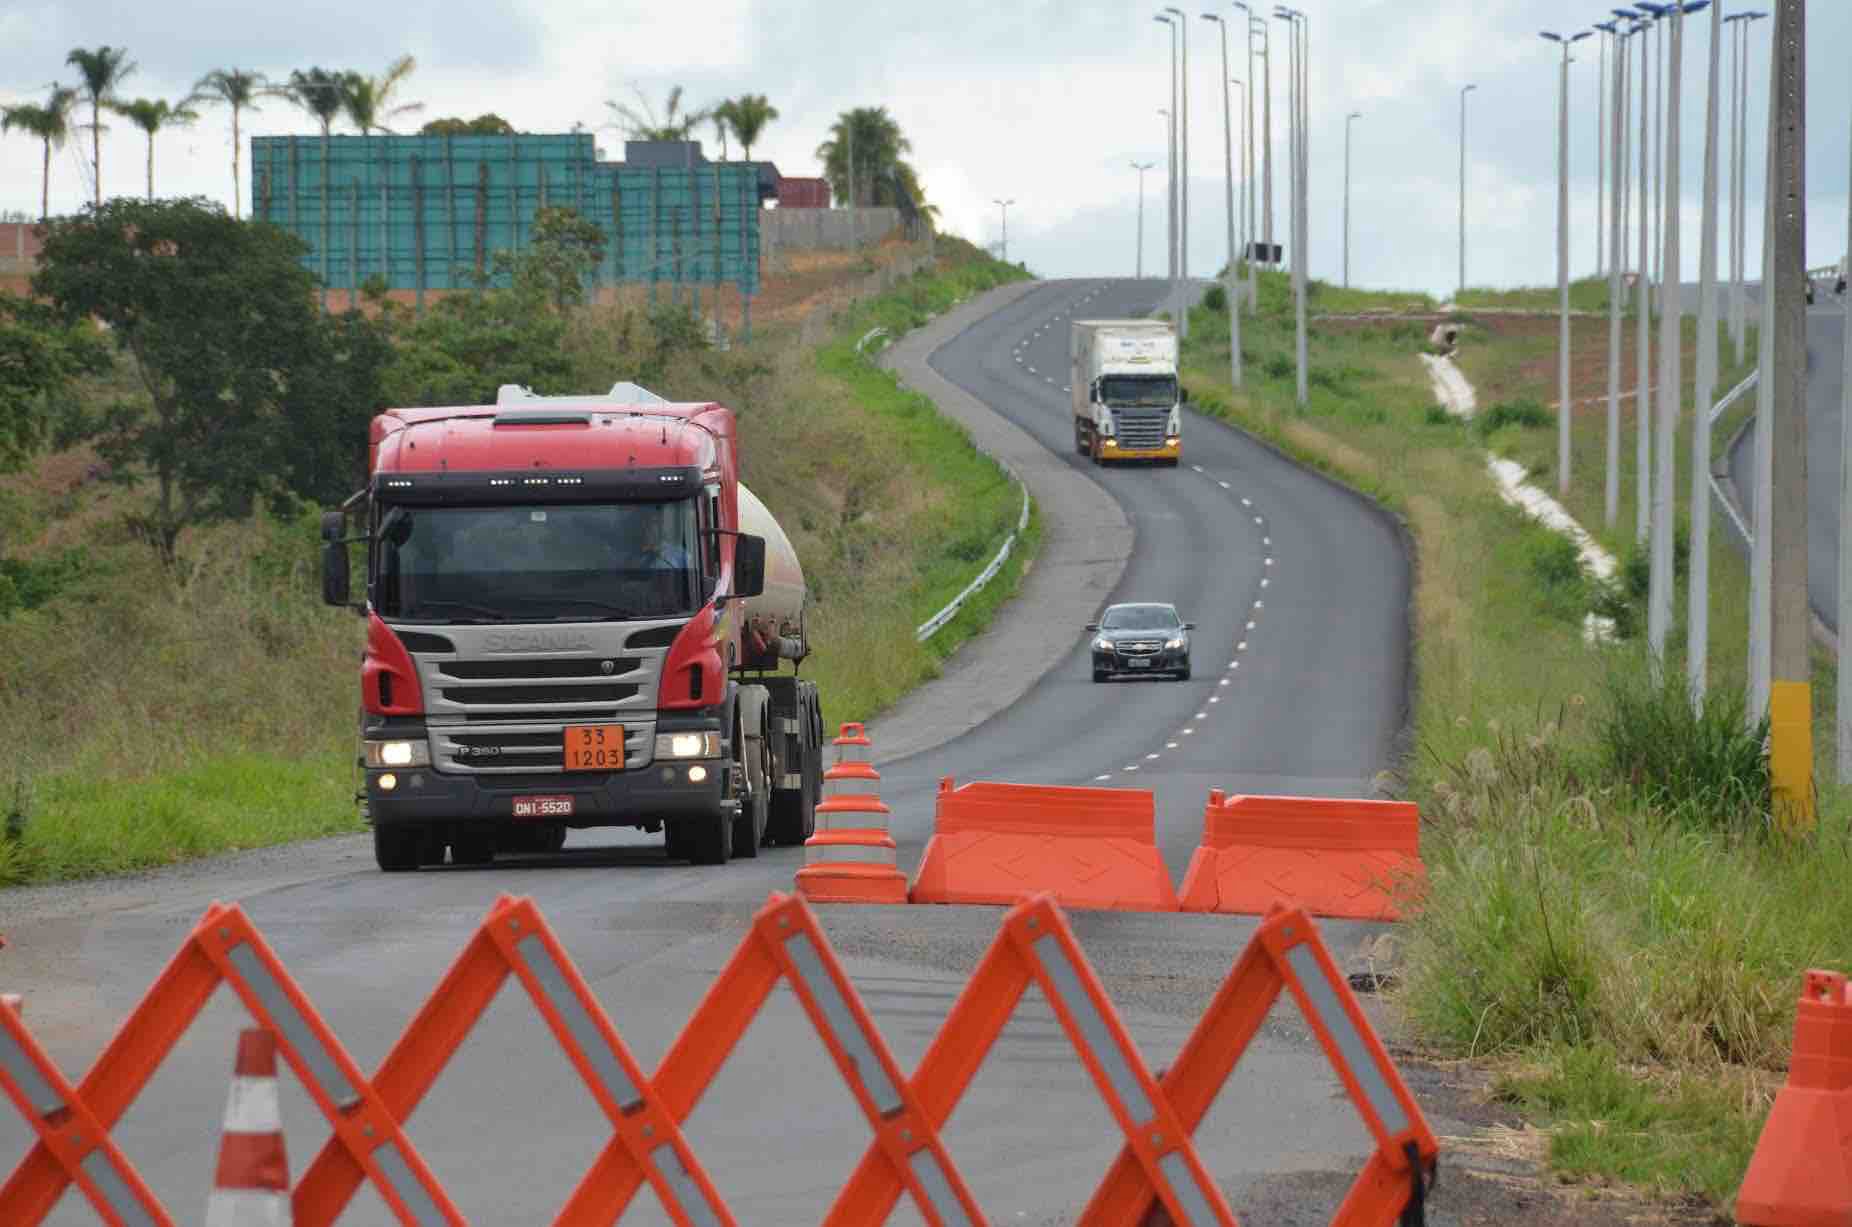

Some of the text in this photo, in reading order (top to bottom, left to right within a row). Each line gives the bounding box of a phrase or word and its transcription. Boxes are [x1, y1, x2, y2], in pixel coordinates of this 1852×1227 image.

[482, 631, 592, 649] SCANIA
[583, 727, 605, 745] 33
[573, 749, 618, 766] 1203
